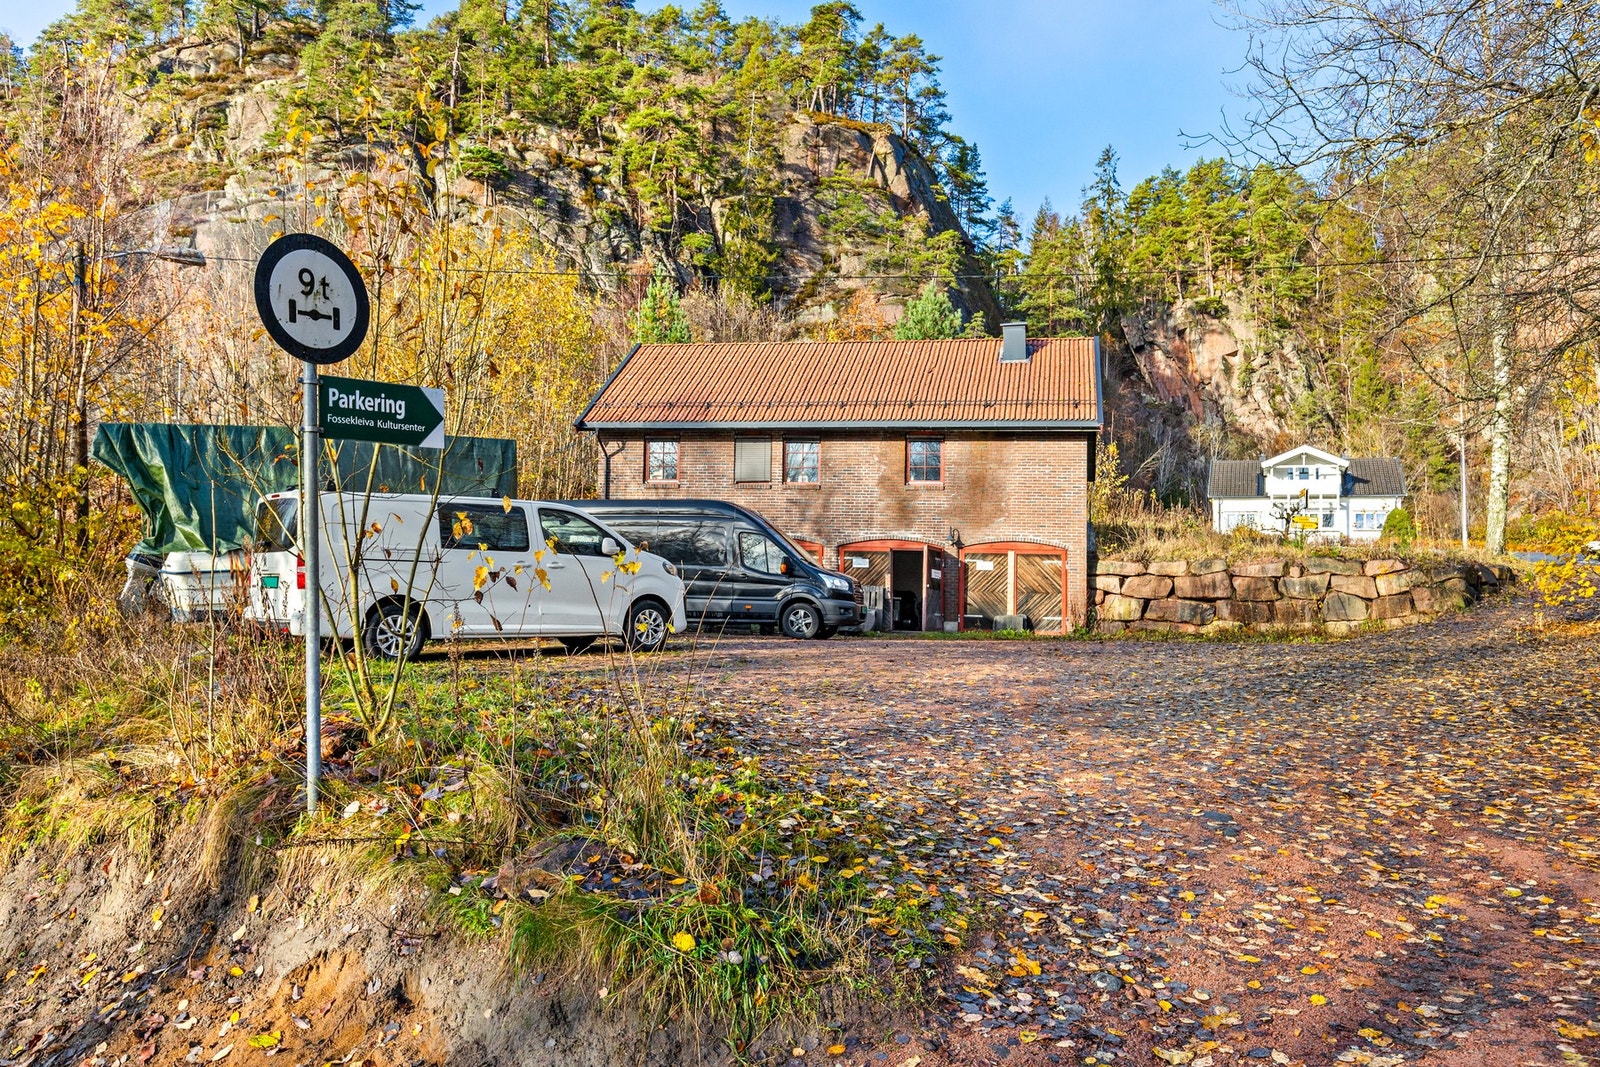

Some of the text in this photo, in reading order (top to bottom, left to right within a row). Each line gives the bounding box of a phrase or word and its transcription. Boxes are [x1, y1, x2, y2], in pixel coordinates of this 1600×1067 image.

[328, 388, 406, 420] Parkering
[327, 413, 426, 432] Fossekleiva Kultursenter
